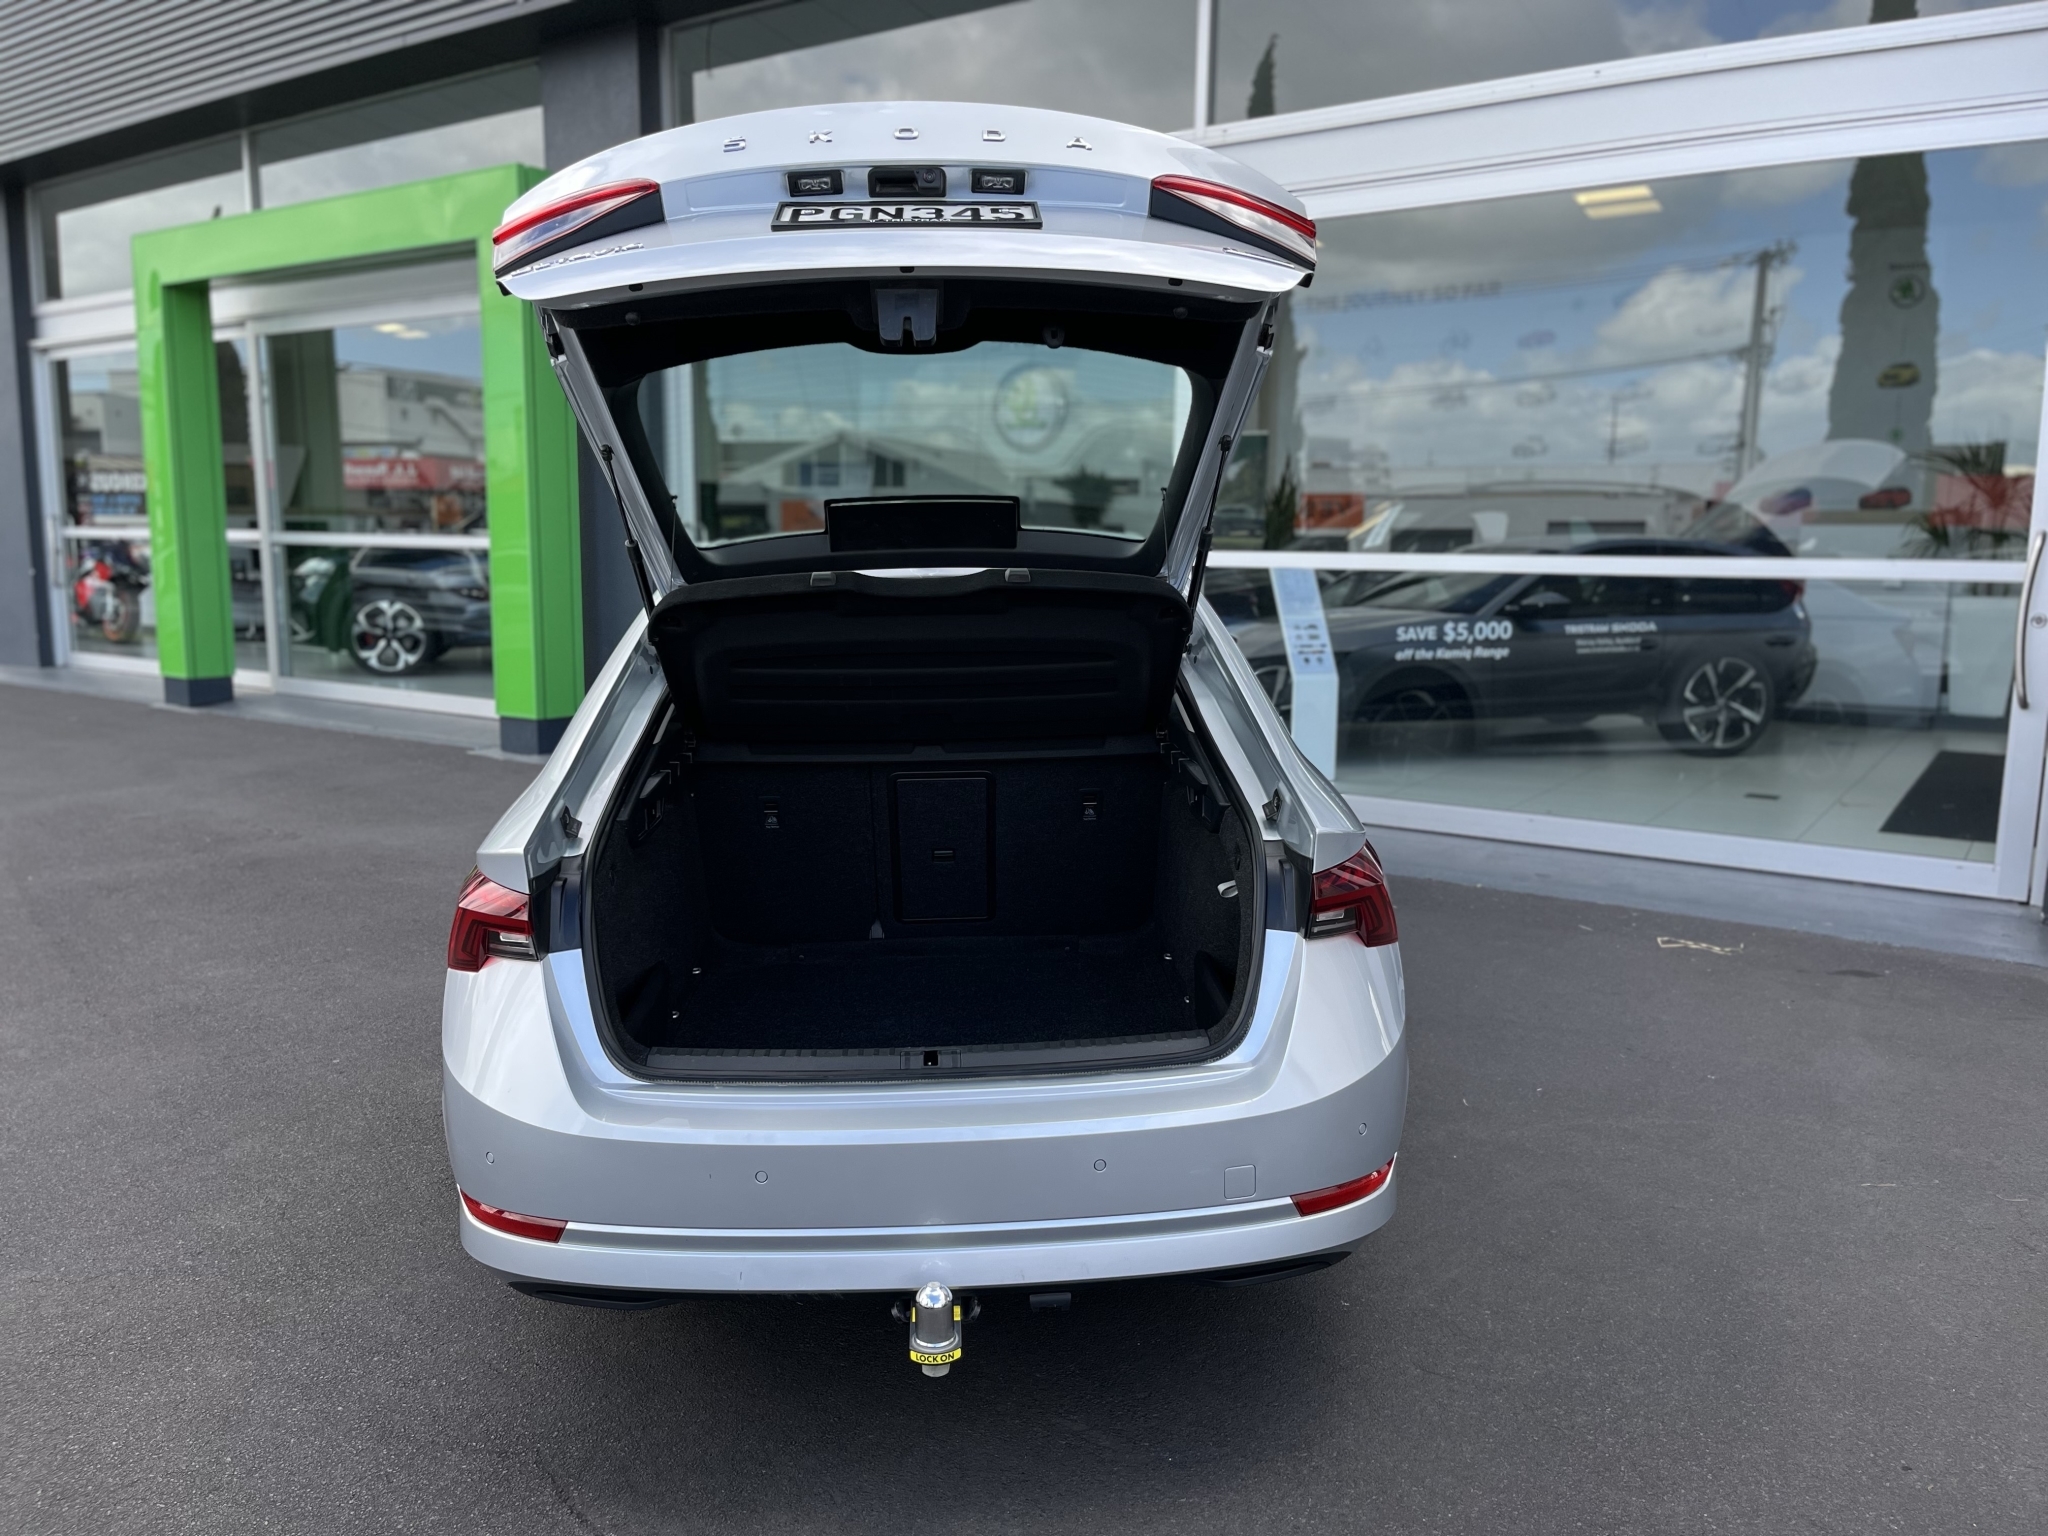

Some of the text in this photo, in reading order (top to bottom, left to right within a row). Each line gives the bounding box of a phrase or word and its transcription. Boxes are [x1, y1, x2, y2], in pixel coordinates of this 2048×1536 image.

[791, 206, 1025, 223] PGN345
[1396, 620, 1513, 644] SAVE $5,000
[1395, 647, 1414, 661] off
[1414, 647, 1435, 661] the
[1473, 645, 1511, 661] Range
[915, 1351, 954, 1363] LOCK ON
